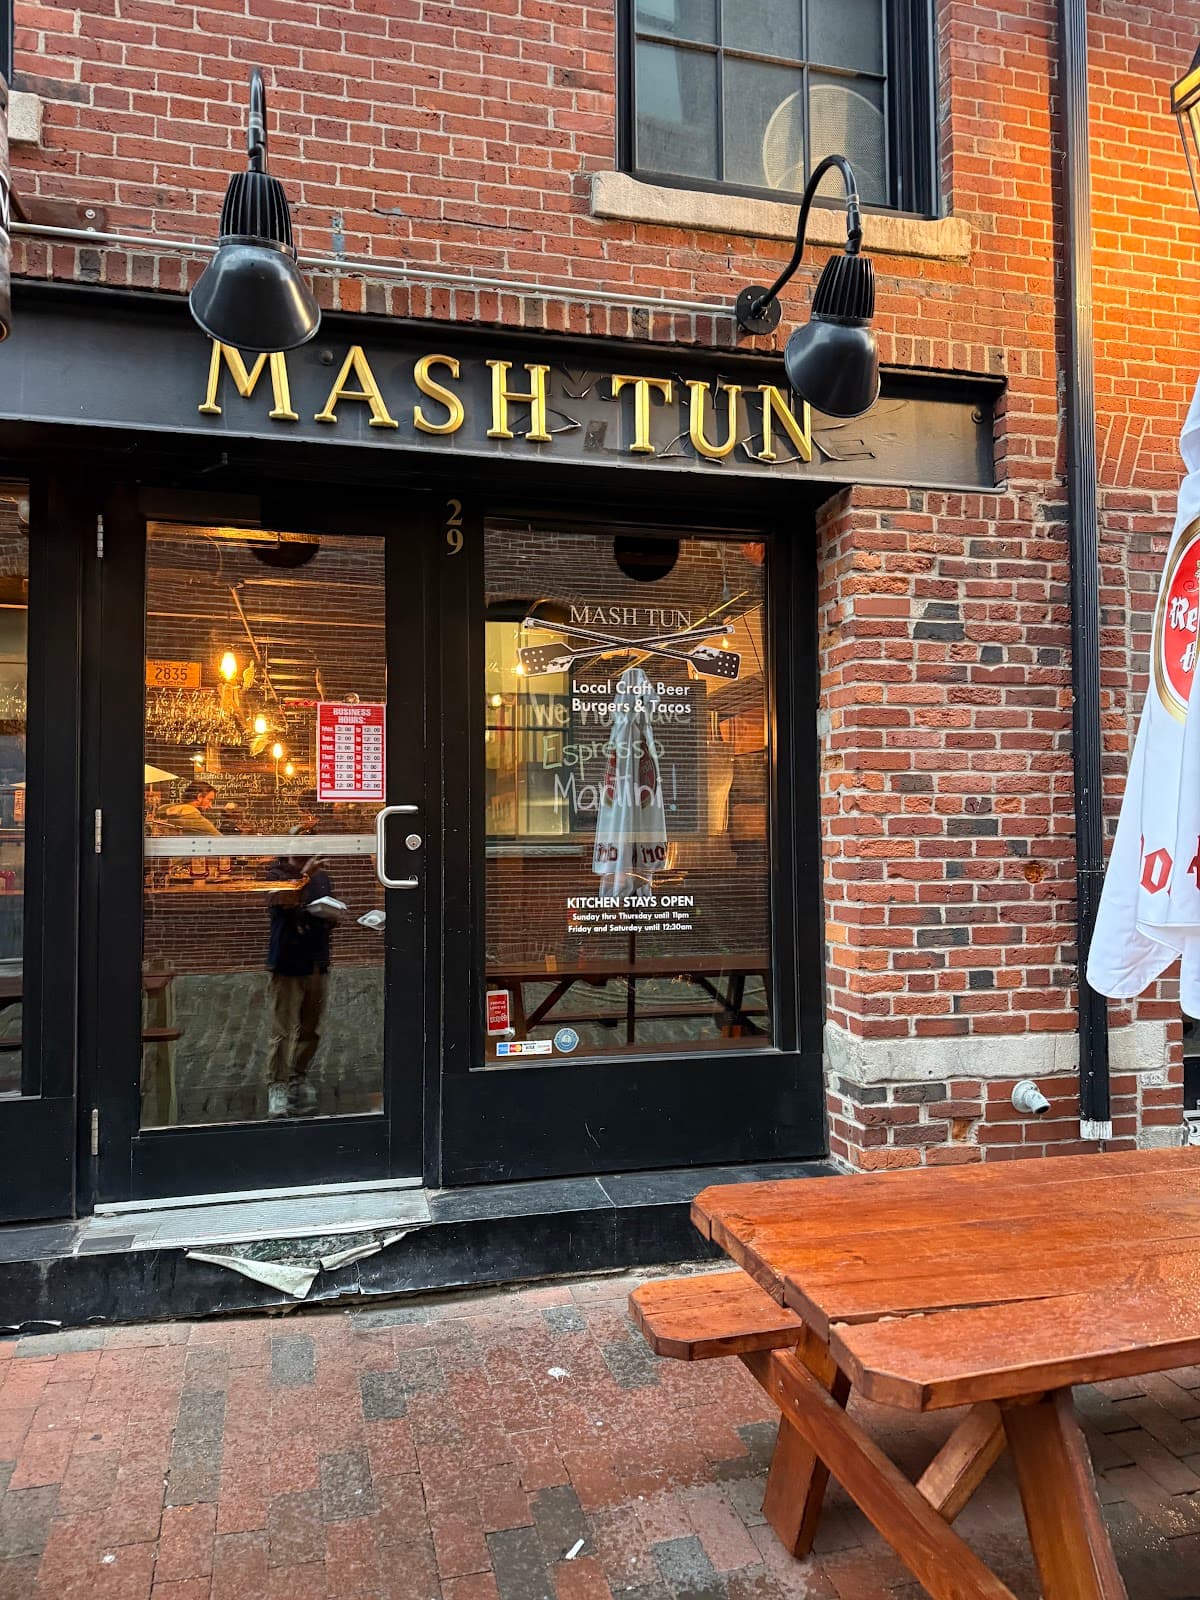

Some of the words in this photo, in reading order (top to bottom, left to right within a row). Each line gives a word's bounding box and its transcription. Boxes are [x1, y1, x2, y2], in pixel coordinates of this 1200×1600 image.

[198, 336, 552, 441] MASH
[611, 373, 812, 462] TUN
[568, 605, 638, 626] MASH
[645, 608, 692, 628] TUN
[154, 667, 188, 681] 2835
[572, 679, 611, 694] Local
[616, 680, 653, 695] Craft
[657, 682, 691, 696] Beer
[332, 707, 372, 717] BUSINESS
[572, 698, 630, 716] Burgers
[634, 700, 646, 713] &
[649, 699, 692, 713] Tacos
[542, 733, 666, 781] Espresso
[567, 897, 620, 909] KITCHEN
[623, 896, 657, 908] STAYS
[660, 895, 694, 907] OPEN
[572, 913, 600, 921] Sunday
[619, 912, 652, 921] Thursday
[568, 925, 592, 933] Friday
[609, 924, 642, 933] Saturday
